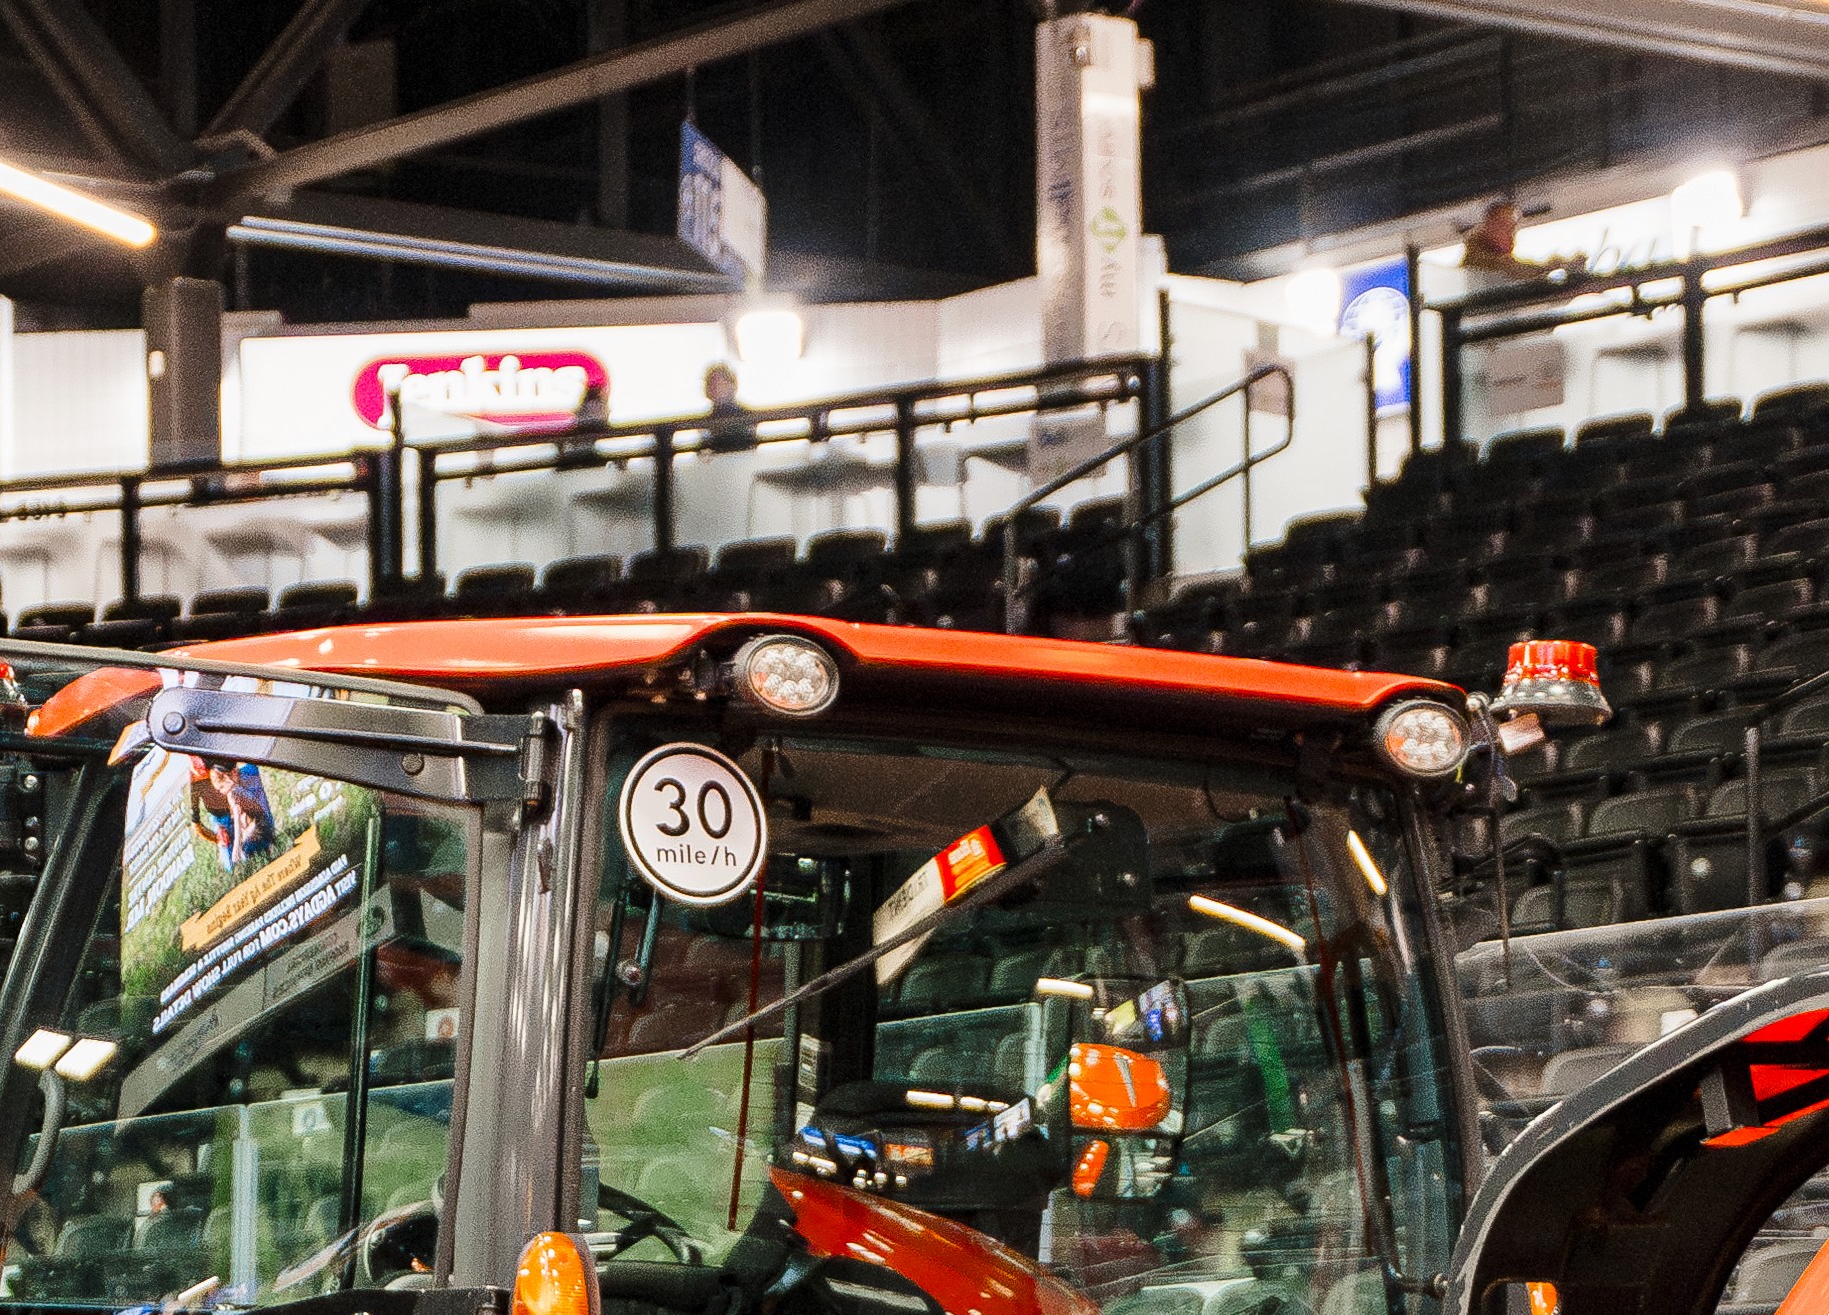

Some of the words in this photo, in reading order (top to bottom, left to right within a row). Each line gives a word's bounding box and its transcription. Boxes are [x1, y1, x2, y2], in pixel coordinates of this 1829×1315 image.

[377, 354, 588, 430] Jenkins
[653, 777, 733, 839] 30
[656, 829, 737, 868] mile/h
